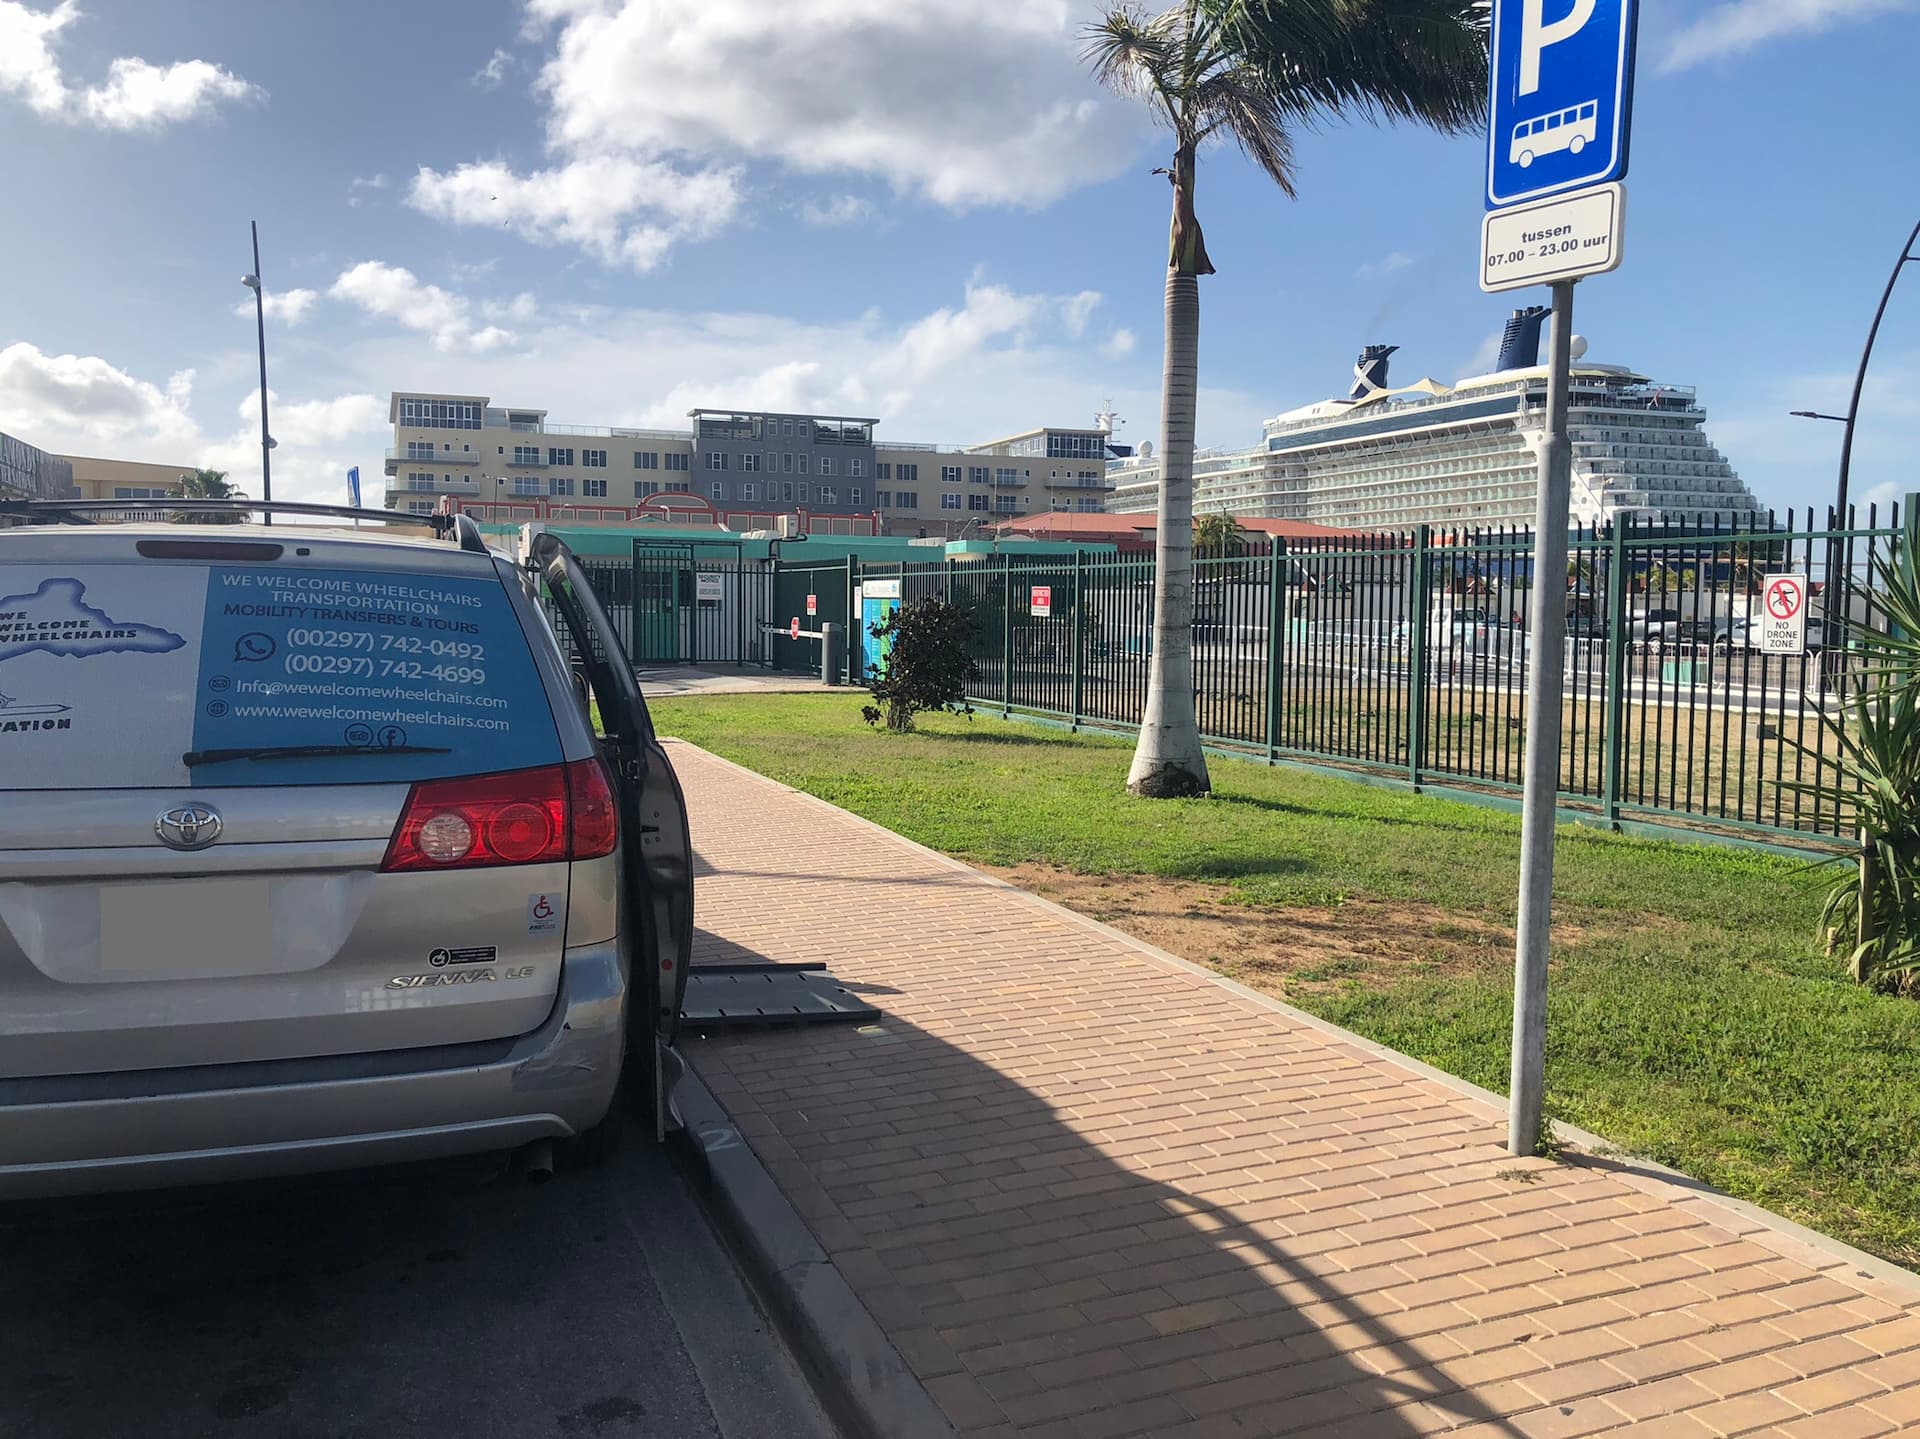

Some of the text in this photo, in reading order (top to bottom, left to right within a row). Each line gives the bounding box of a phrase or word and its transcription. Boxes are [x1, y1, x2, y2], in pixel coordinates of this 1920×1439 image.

[1519, 0, 1597, 97] P
[1521, 224, 1572, 243] tussen
[1488, 250, 1525, 267] 07.00
[1539, 239, 1578, 257] 23.00
[1583, 235, 1608, 248] uur
[223, 575, 482, 608] WE WELCOME WHEELCHAIRS
[271, 590, 439, 615] TRANSPORTATION
[223, 603, 479, 634] MOBILITY TRANSFERS & TOURS
[1775, 621, 1789, 630] NO
[286, 628, 486, 660] (00297) 742-0492
[1767, 630, 1798, 639] DRONE
[1769, 639, 1794, 648] ZONE
[284, 653, 486, 685] (00297) 742-4699
[236, 679, 508, 709] Info@wewelcomewheelchairs.com
[0, 718, 72, 732] ATION
[234, 704, 510, 731] www.wewelcomewheelchairs.com
[385, 966, 536, 990] SIENNA LE
